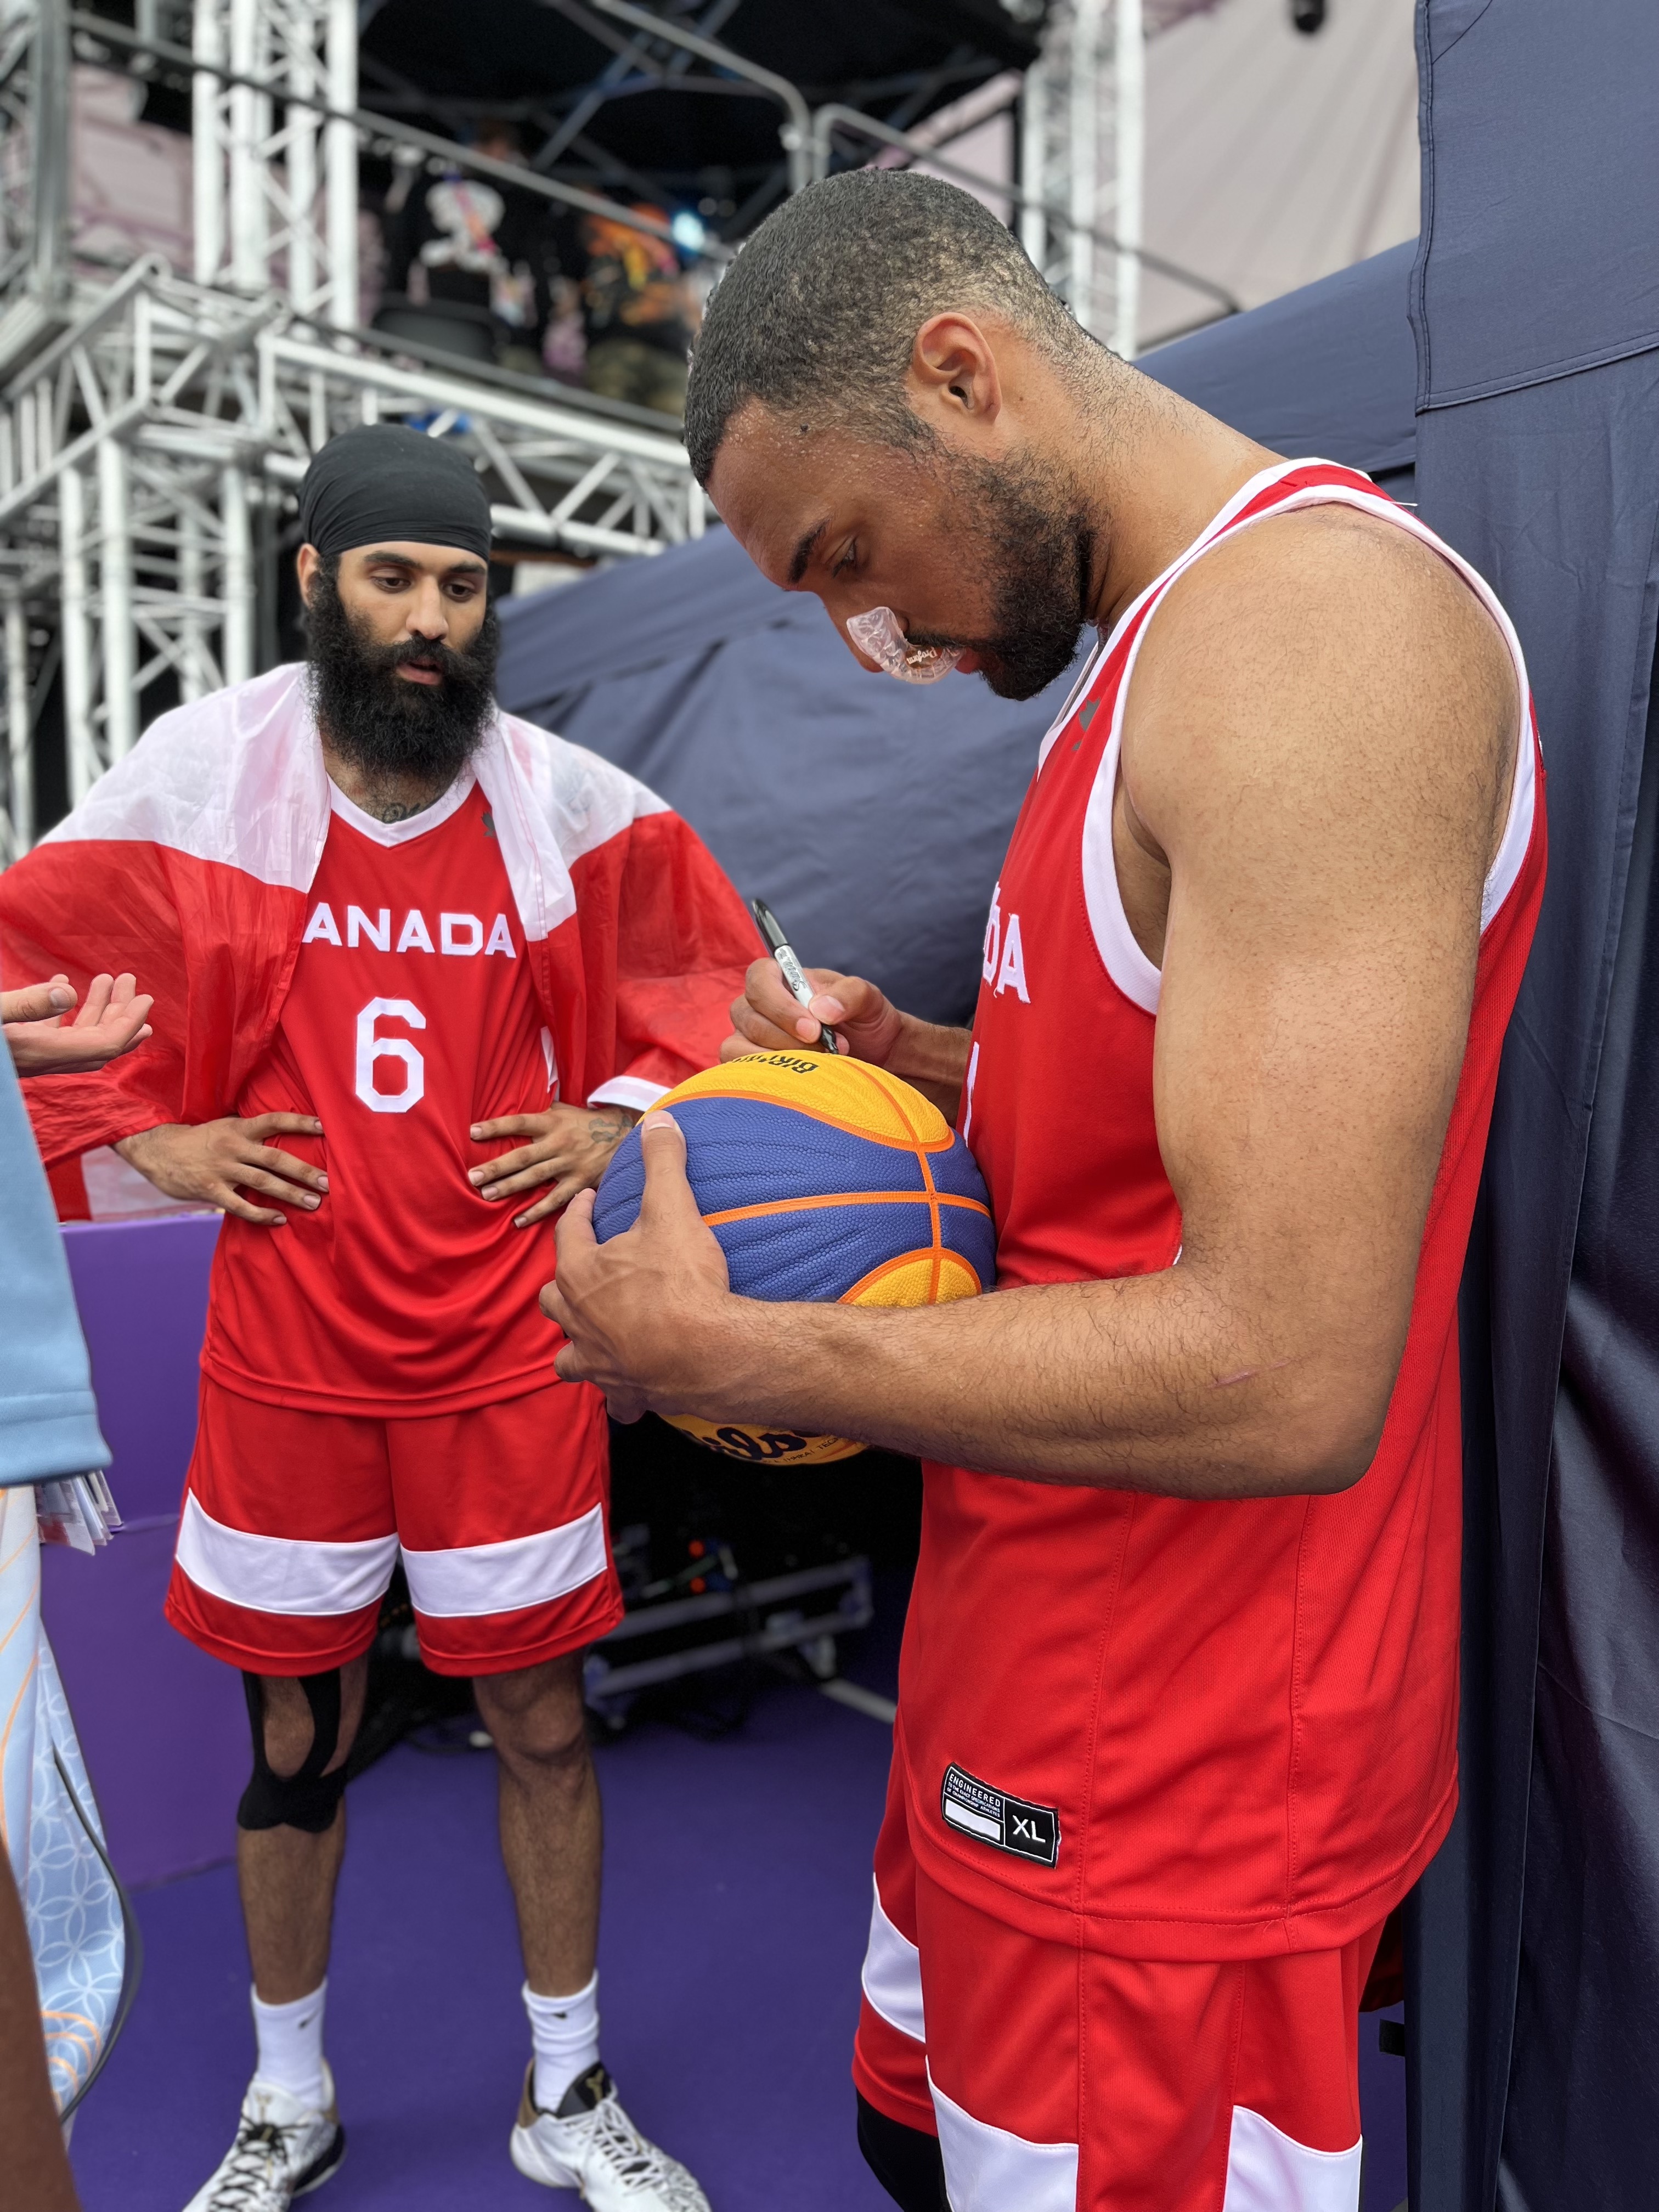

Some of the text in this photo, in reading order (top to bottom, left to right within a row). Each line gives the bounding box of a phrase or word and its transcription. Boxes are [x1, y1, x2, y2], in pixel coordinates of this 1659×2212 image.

[302, 902, 517, 958] ANADA
[355, 996, 426, 1113] 6
[949, 1774, 1001, 1807] ENGINEERED
[952, 1791, 979, 1808] CHAMPIONSHIP
[980, 1806, 1001, 1818] ATHLETES
[960, 1789, 970, 1798] EXACT
[971, 1796, 1001, 1813] SPECIFICATIONS
[1013, 1815, 1046, 1843] XL
